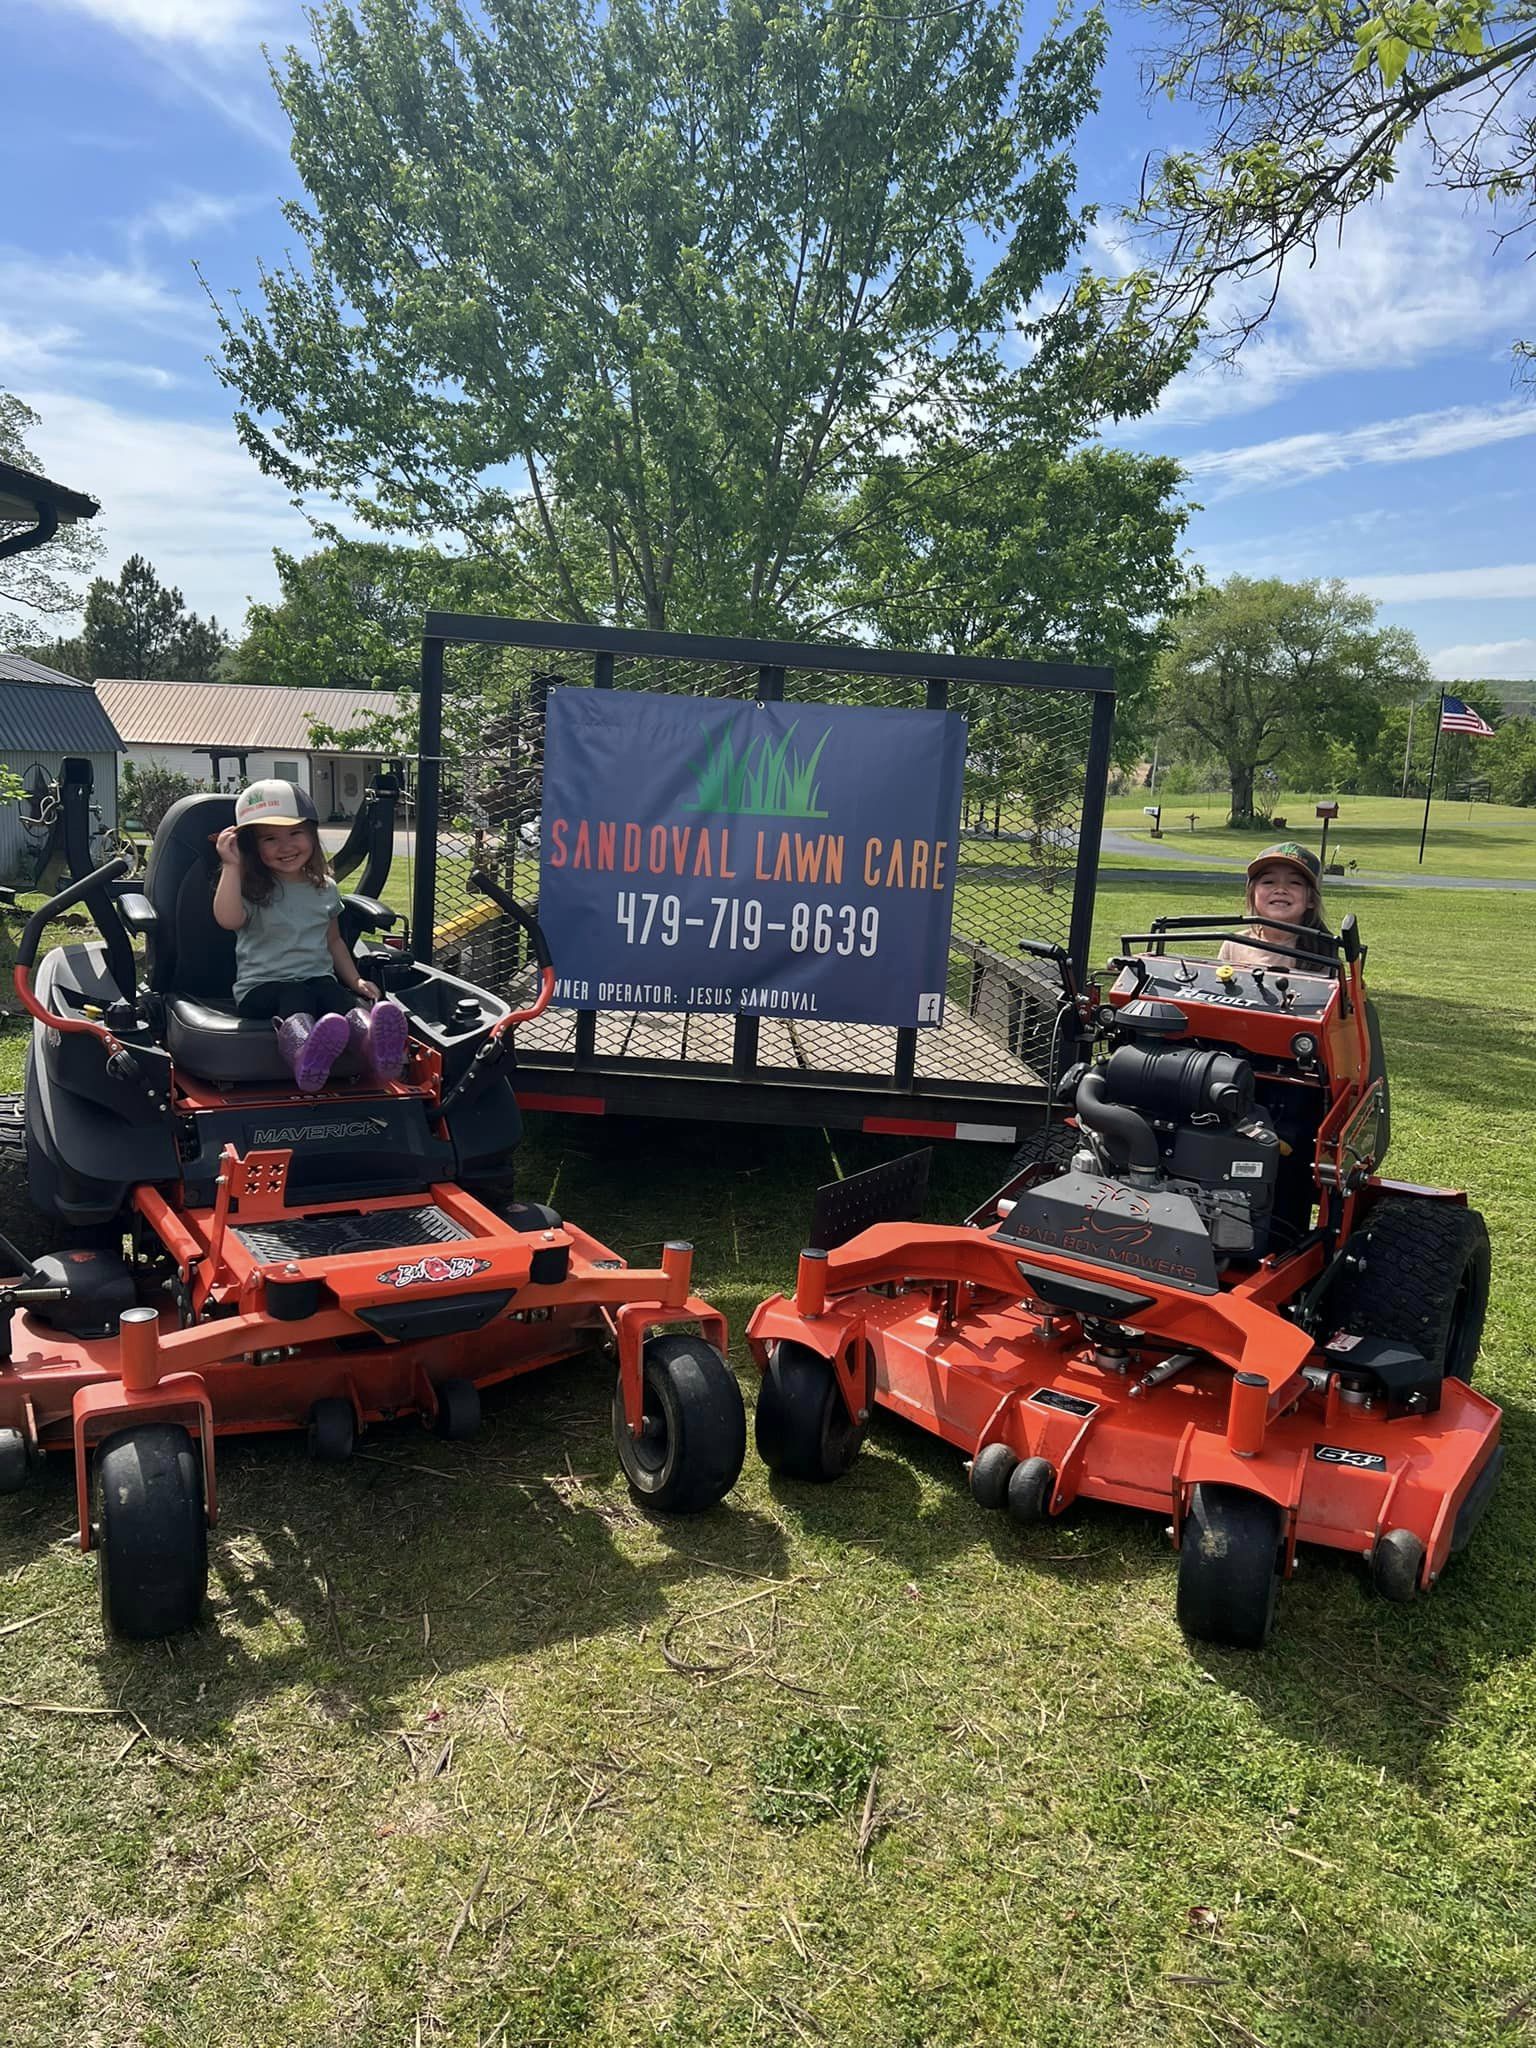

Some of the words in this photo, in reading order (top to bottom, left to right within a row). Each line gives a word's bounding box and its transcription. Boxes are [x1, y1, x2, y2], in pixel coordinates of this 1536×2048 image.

[551, 818, 736, 880] SANDOVAL
[755, 831, 845, 885] LAWN
[864, 837, 948, 890] CARE
[617, 891, 880, 957] 479-719-8639
[598, 982, 678, 1004] OPERATOR:
[687, 986, 732, 1006] JESUS
[740, 987, 818, 1012] SANDOVAL
[1174, 986, 1259, 1007] REVOLT
[253, 1121, 381, 1145] MAVERICK
[1018, 1224, 1057, 1244] BAD
[1063, 1236, 1103, 1253] BOY
[1108, 1247, 1198, 1280] MOWERS
